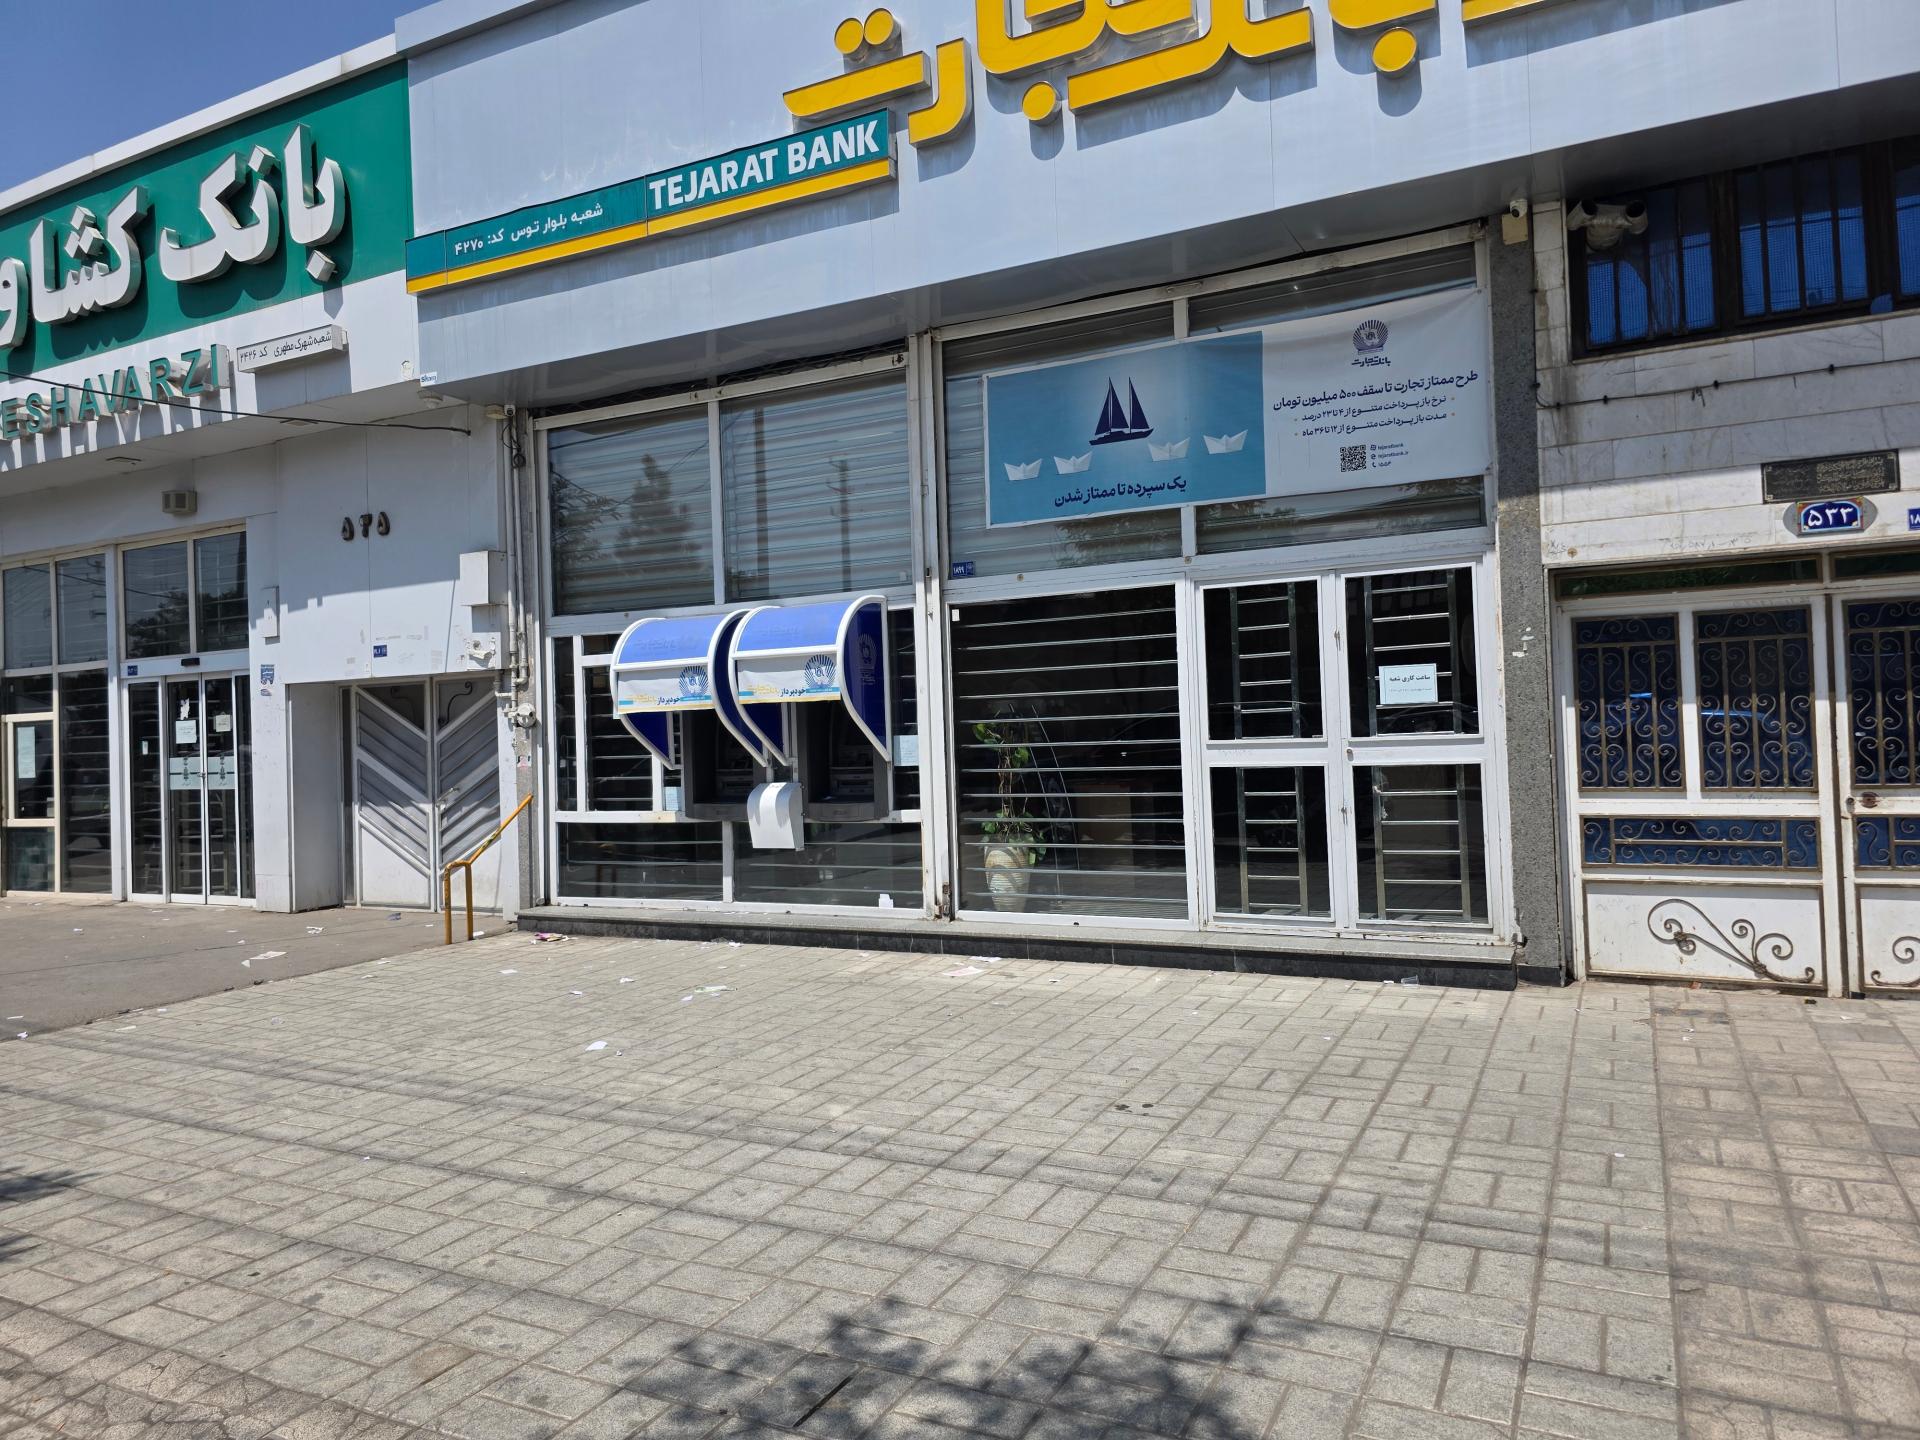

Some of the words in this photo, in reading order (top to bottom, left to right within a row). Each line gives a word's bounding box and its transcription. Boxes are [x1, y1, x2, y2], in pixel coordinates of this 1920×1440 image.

[650, 148, 778, 210] TEJARAT
[787, 120, 880, 175] BANK
[160, 122, 346, 283] بانک
[571, 202, 604, 224] شعبه
[511, 221, 540, 242] توس
[542, 213, 567, 235] بلوار
[487, 227, 504, 244] کد:
[454, 240, 484, 256] ۴۲۷۰
[294, 335, 313, 352] شهرک
[314, 331, 332, 346] شعبه
[259, 346, 268, 358] کد
[274, 342, 294, 357] مطهری
[1352, 356, 1378, 368] تجارت
[1370, 356, 1392, 367] بانک
[1394, 378, 1424, 393] تجارت
[1424, 376, 1455, 390] ممتاز
[1456, 370, 1478, 388] طرح
[1339, 389, 1356, 400] ۵۰۰
[1356, 385, 1384, 397] سقف
[1384, 382, 1392, 392] تا
[1273, 396, 1300, 410] تومان
[1302, 391, 1338, 406] میلیون
[1432, 395, 1446, 407] نرخ
[1302, 412, 1321, 422] درصد
[1344, 408, 1350, 418] از
[1425, 412, 1446, 421] مدت
[1324, 426, 1330, 434] تا
[1337, 424, 1344, 434] از
[1117, 482, 1126, 496] تا
[1127, 482, 1166, 499] سپرده
[1167, 476, 1186, 492] یک
[1054, 488, 1083, 507] شدن
[1083, 486, 1116, 504] ممتاز
[1807, 507, 1854, 527] ۵۳۳
[1402, 674, 1415, 682] کاری
